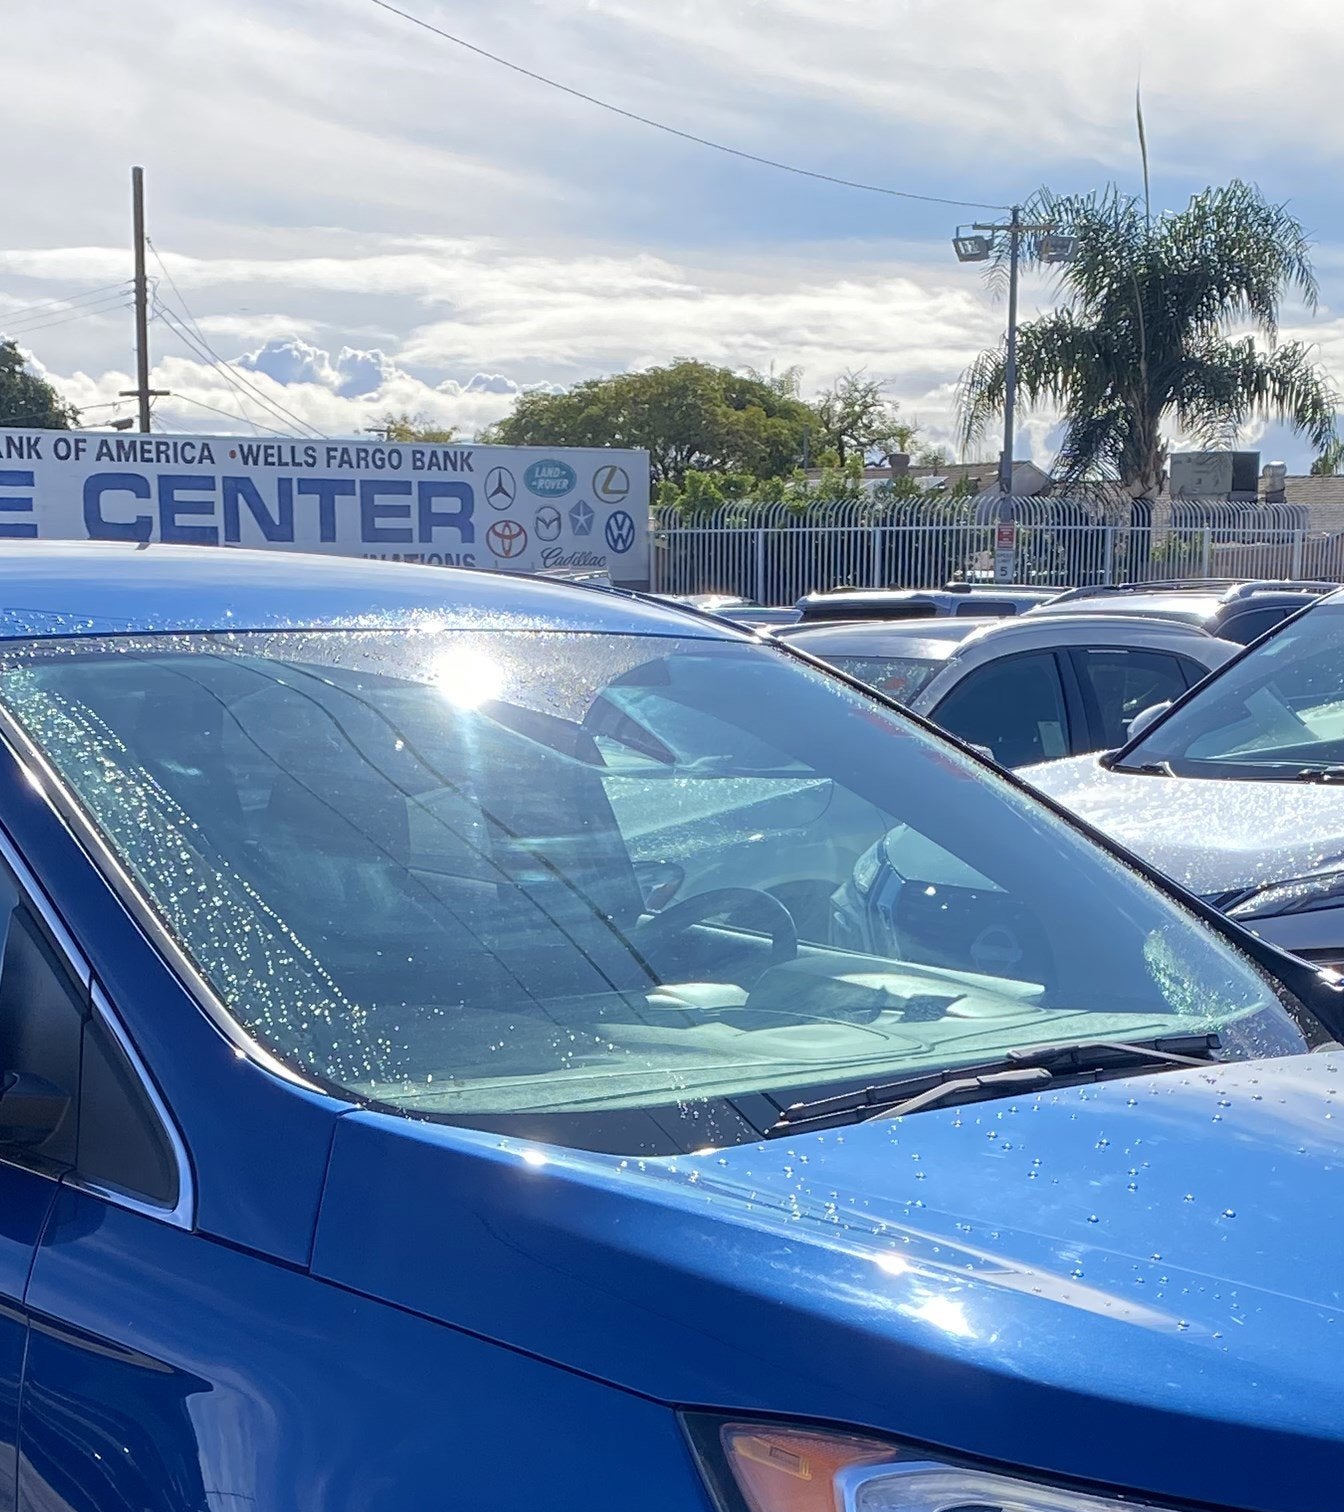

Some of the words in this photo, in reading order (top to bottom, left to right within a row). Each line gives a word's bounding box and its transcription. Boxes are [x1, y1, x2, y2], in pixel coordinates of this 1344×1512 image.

[52, 437, 87, 461] OF
[94, 439, 216, 466] AMERICA
[237, 442, 318, 469] WELLS
[326, 446, 403, 471] FARGO
[412, 450, 474, 472] BANK
[82, 471, 475, 546] CENTER
[541, 546, 607, 569] Cadillac
